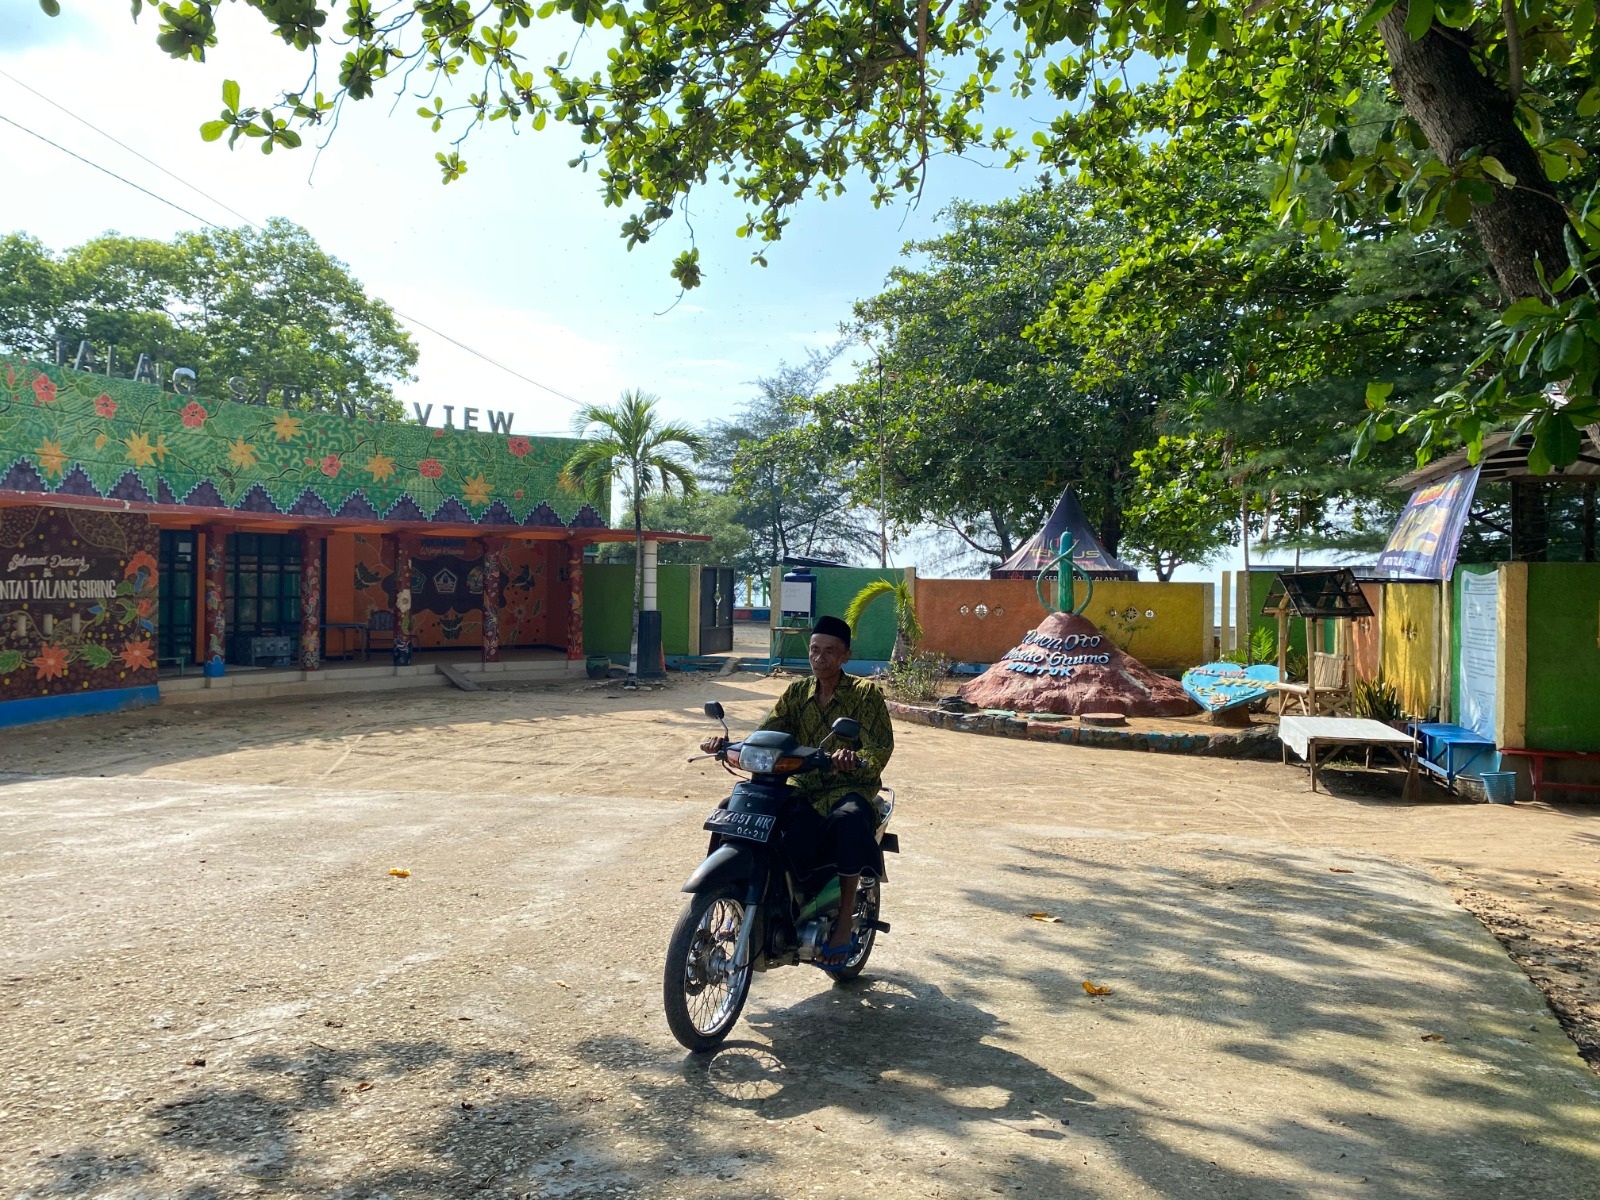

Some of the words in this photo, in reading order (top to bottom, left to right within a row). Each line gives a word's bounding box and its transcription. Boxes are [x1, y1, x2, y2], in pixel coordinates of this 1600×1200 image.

[413, 402, 515, 434] VIEW
[30, 580, 78, 600] TALANG
[79, 579, 117, 599] SIRING
